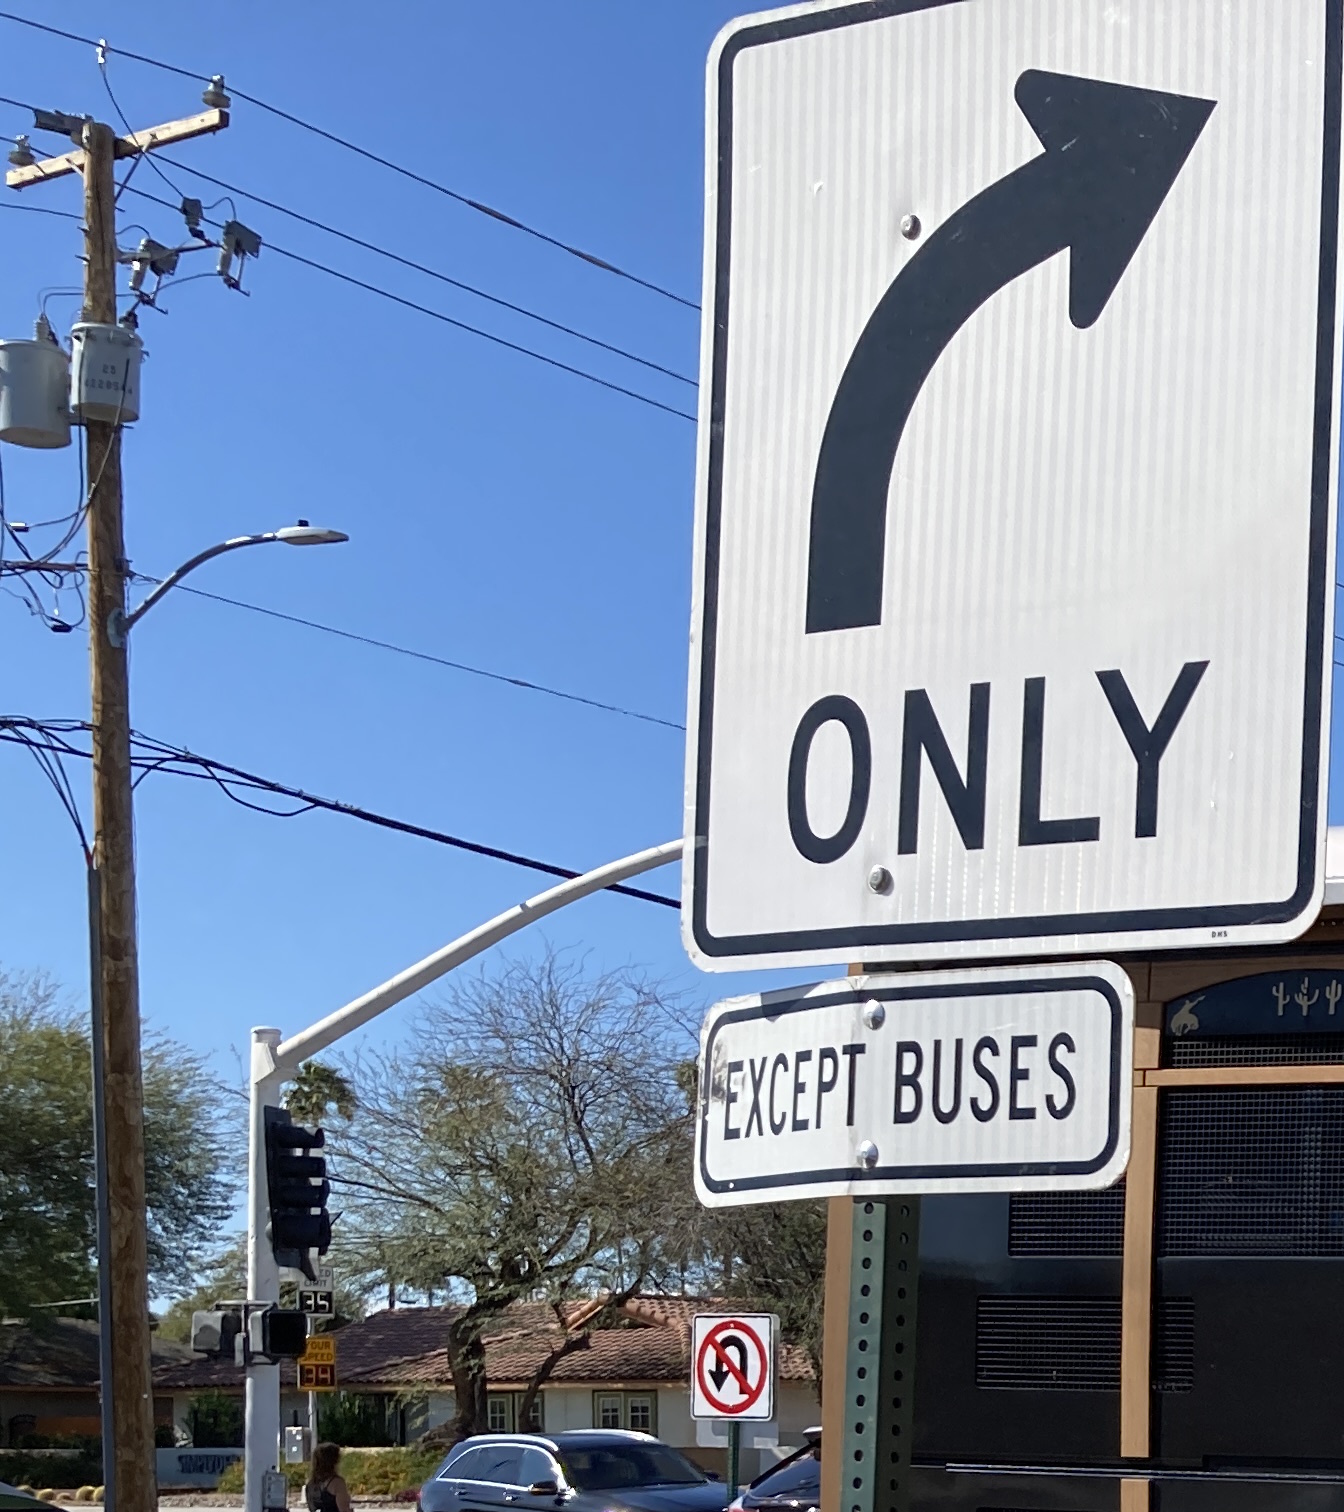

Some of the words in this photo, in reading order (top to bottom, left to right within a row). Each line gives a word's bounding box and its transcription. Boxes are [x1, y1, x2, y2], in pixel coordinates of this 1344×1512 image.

[787, 660, 1210, 865] ONLY
[723, 1042, 866, 1141] EXCEPT
[893, 1031, 1077, 1125] BUSES
[302, 1291, 330, 1313] 35
